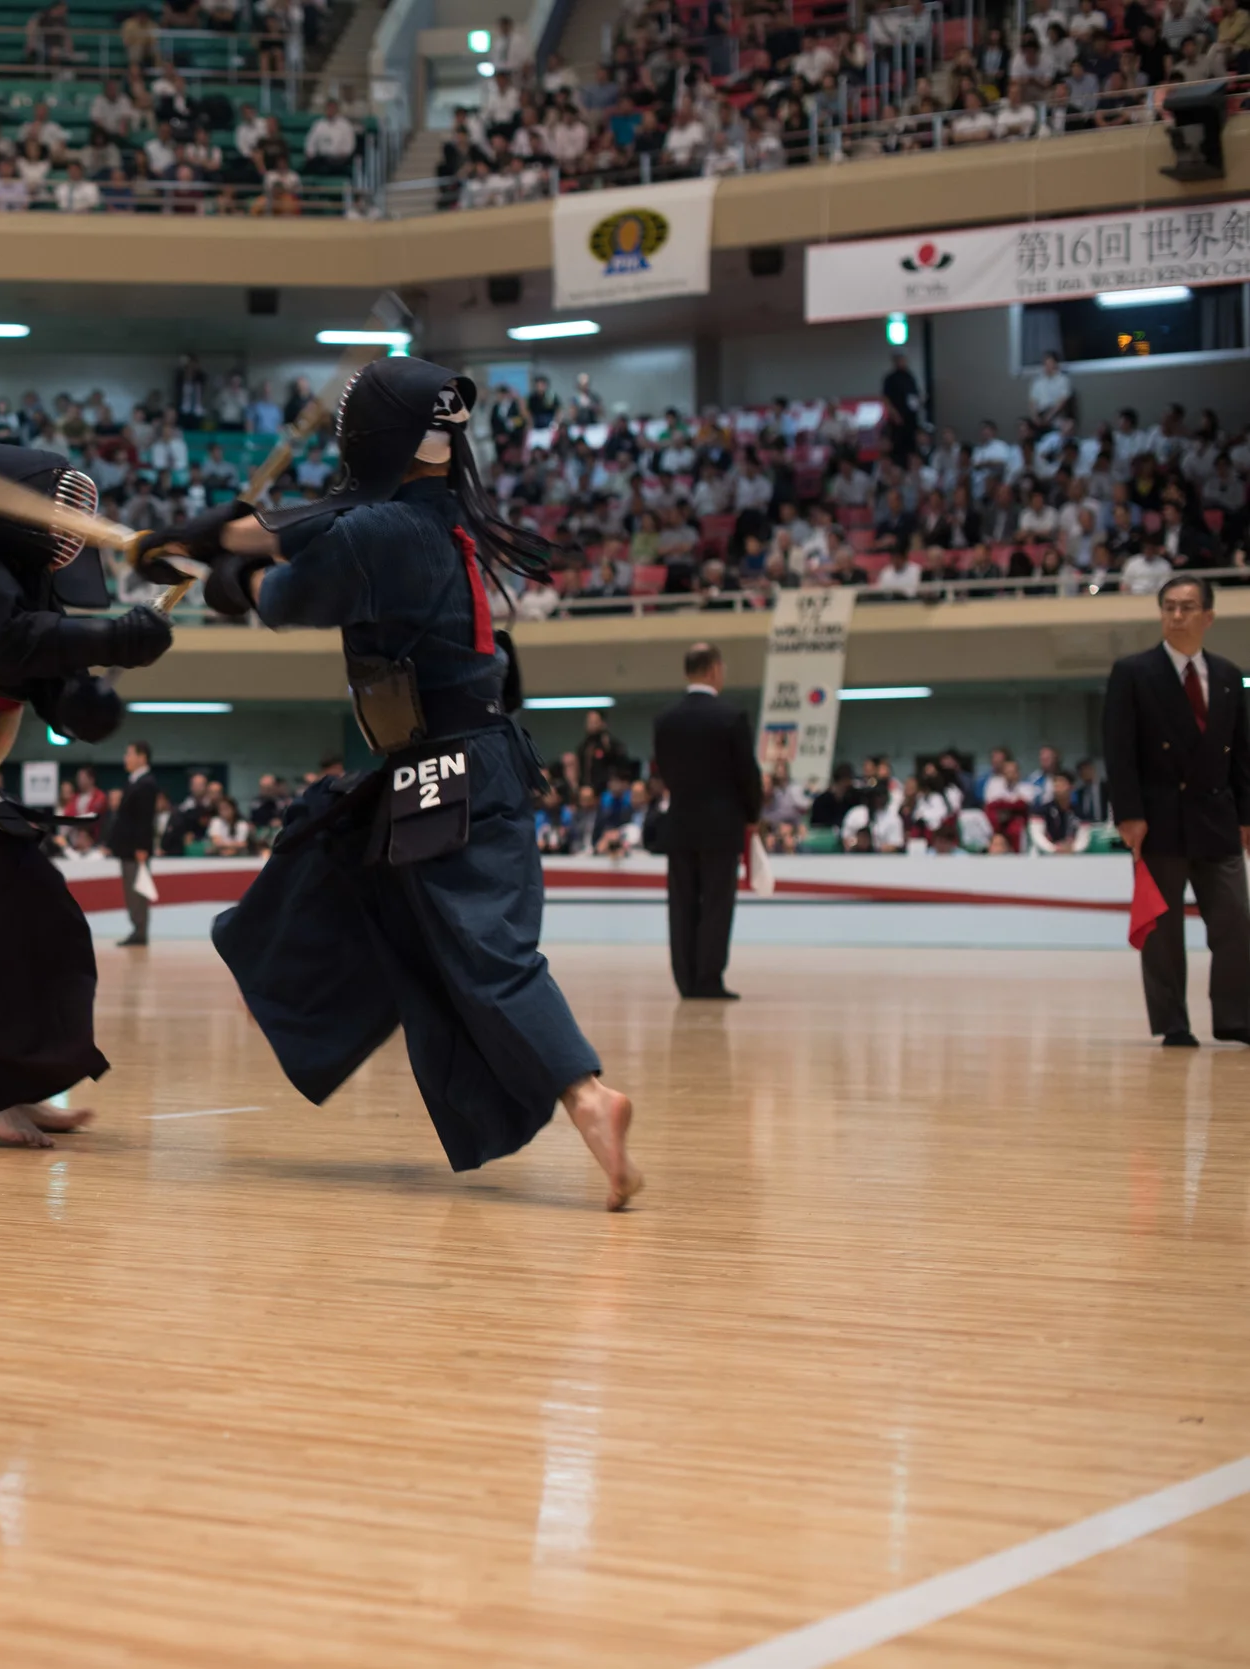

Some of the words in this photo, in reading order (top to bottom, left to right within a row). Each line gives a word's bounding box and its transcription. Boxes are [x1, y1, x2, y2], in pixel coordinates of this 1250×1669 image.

[1015, 221, 1132, 277] 第16回
[1016, 277, 1047, 297] THE
[1090, 267, 1154, 289] WORLD
[1156, 261, 1221, 282] KENDO
[393, 752, 466, 792] DEN
[419, 782, 441, 809] 2
